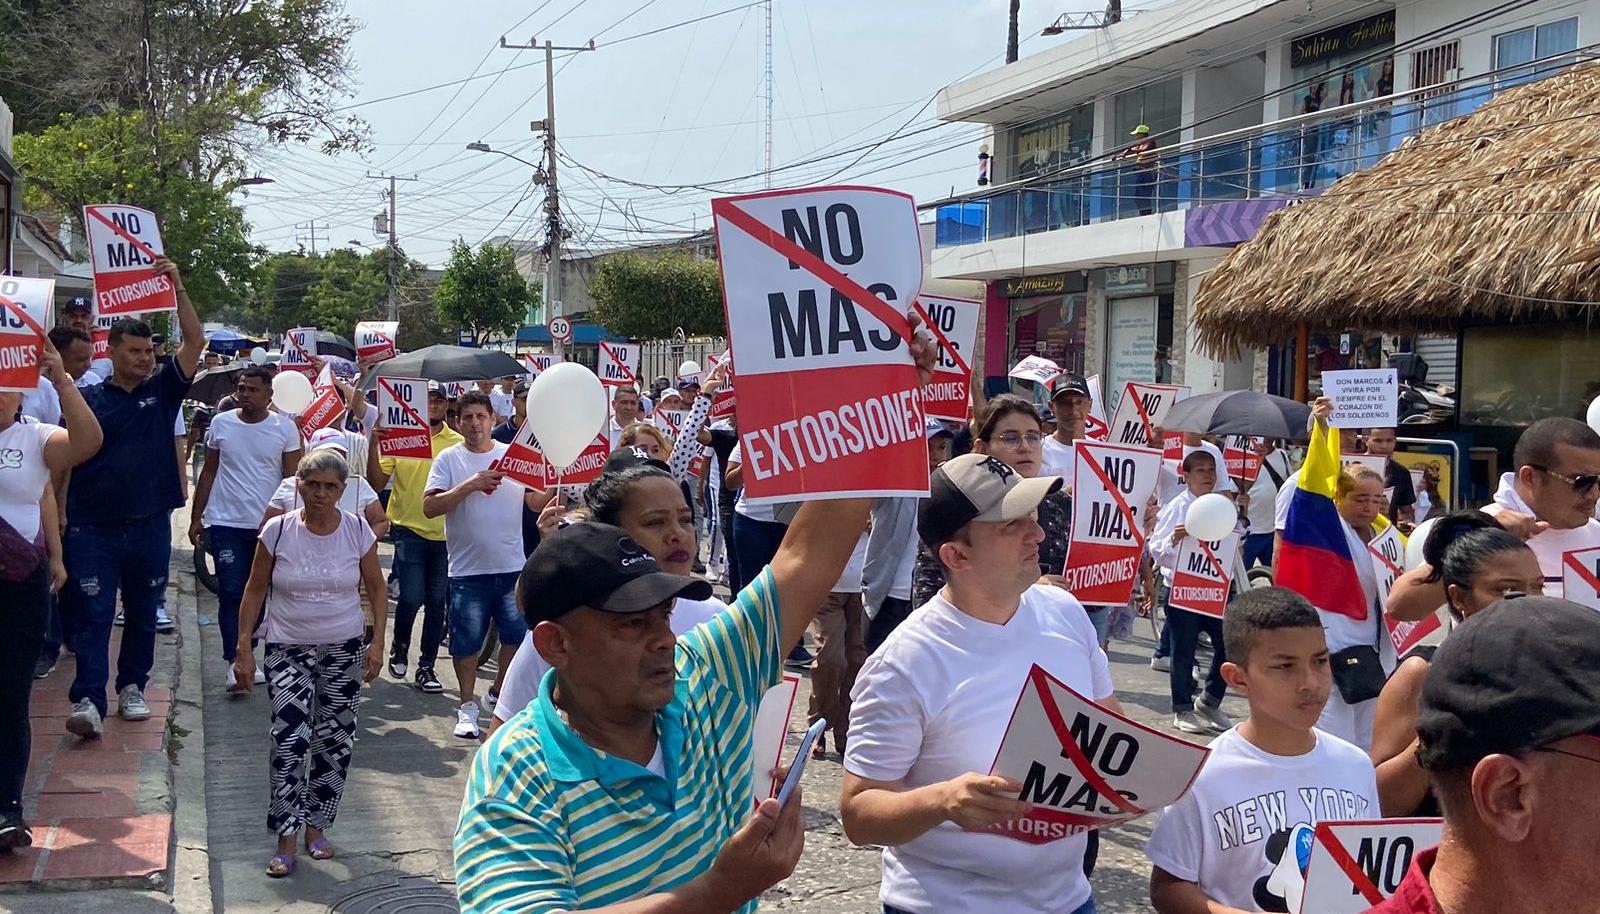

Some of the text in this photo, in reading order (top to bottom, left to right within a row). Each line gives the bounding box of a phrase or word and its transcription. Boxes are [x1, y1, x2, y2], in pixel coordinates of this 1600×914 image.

[111, 212, 141, 236] NO
[781, 203, 864, 270] NO
[99, 274, 171, 310] EXTORSIONES
[553, 323, 567, 333] 30
[926, 303, 956, 333] NO
[294, 332, 305, 346] NO
[611, 347, 628, 362] NO
[394, 383, 412, 403] NO
[1136, 393, 1162, 417] NO
[667, 412, 681, 426] NO
[742, 387, 923, 481] EXTORSIONES
[1103, 456, 1136, 494] NO
[1381, 537, 1397, 568] NO
[1173, 586, 1224, 601] EXTORSIONES
[1060, 711, 1140, 777] NO
[1213, 787, 1369, 850] NEW YORK
[1352, 836, 1414, 895] NO
